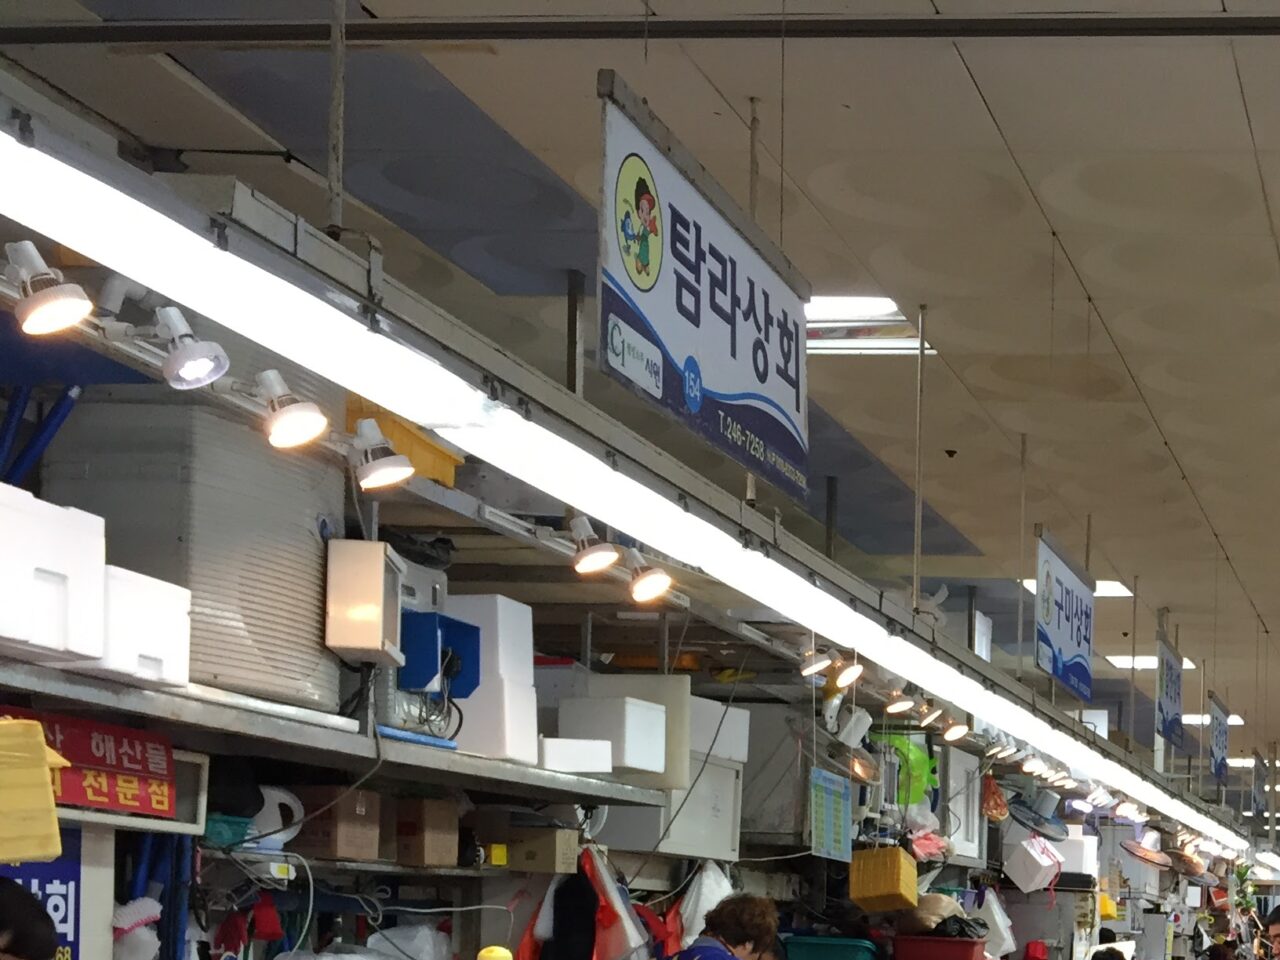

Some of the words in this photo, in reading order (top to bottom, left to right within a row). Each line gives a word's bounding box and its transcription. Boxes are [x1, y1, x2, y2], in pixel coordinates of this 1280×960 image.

[668, 201, 801, 413] 탐라상회
[684, 369, 701, 401] 154
[1054, 576, 1092, 657] 구미상회
[90, 731, 168, 775] 해산물
[82, 769, 169, 811] 전문점
